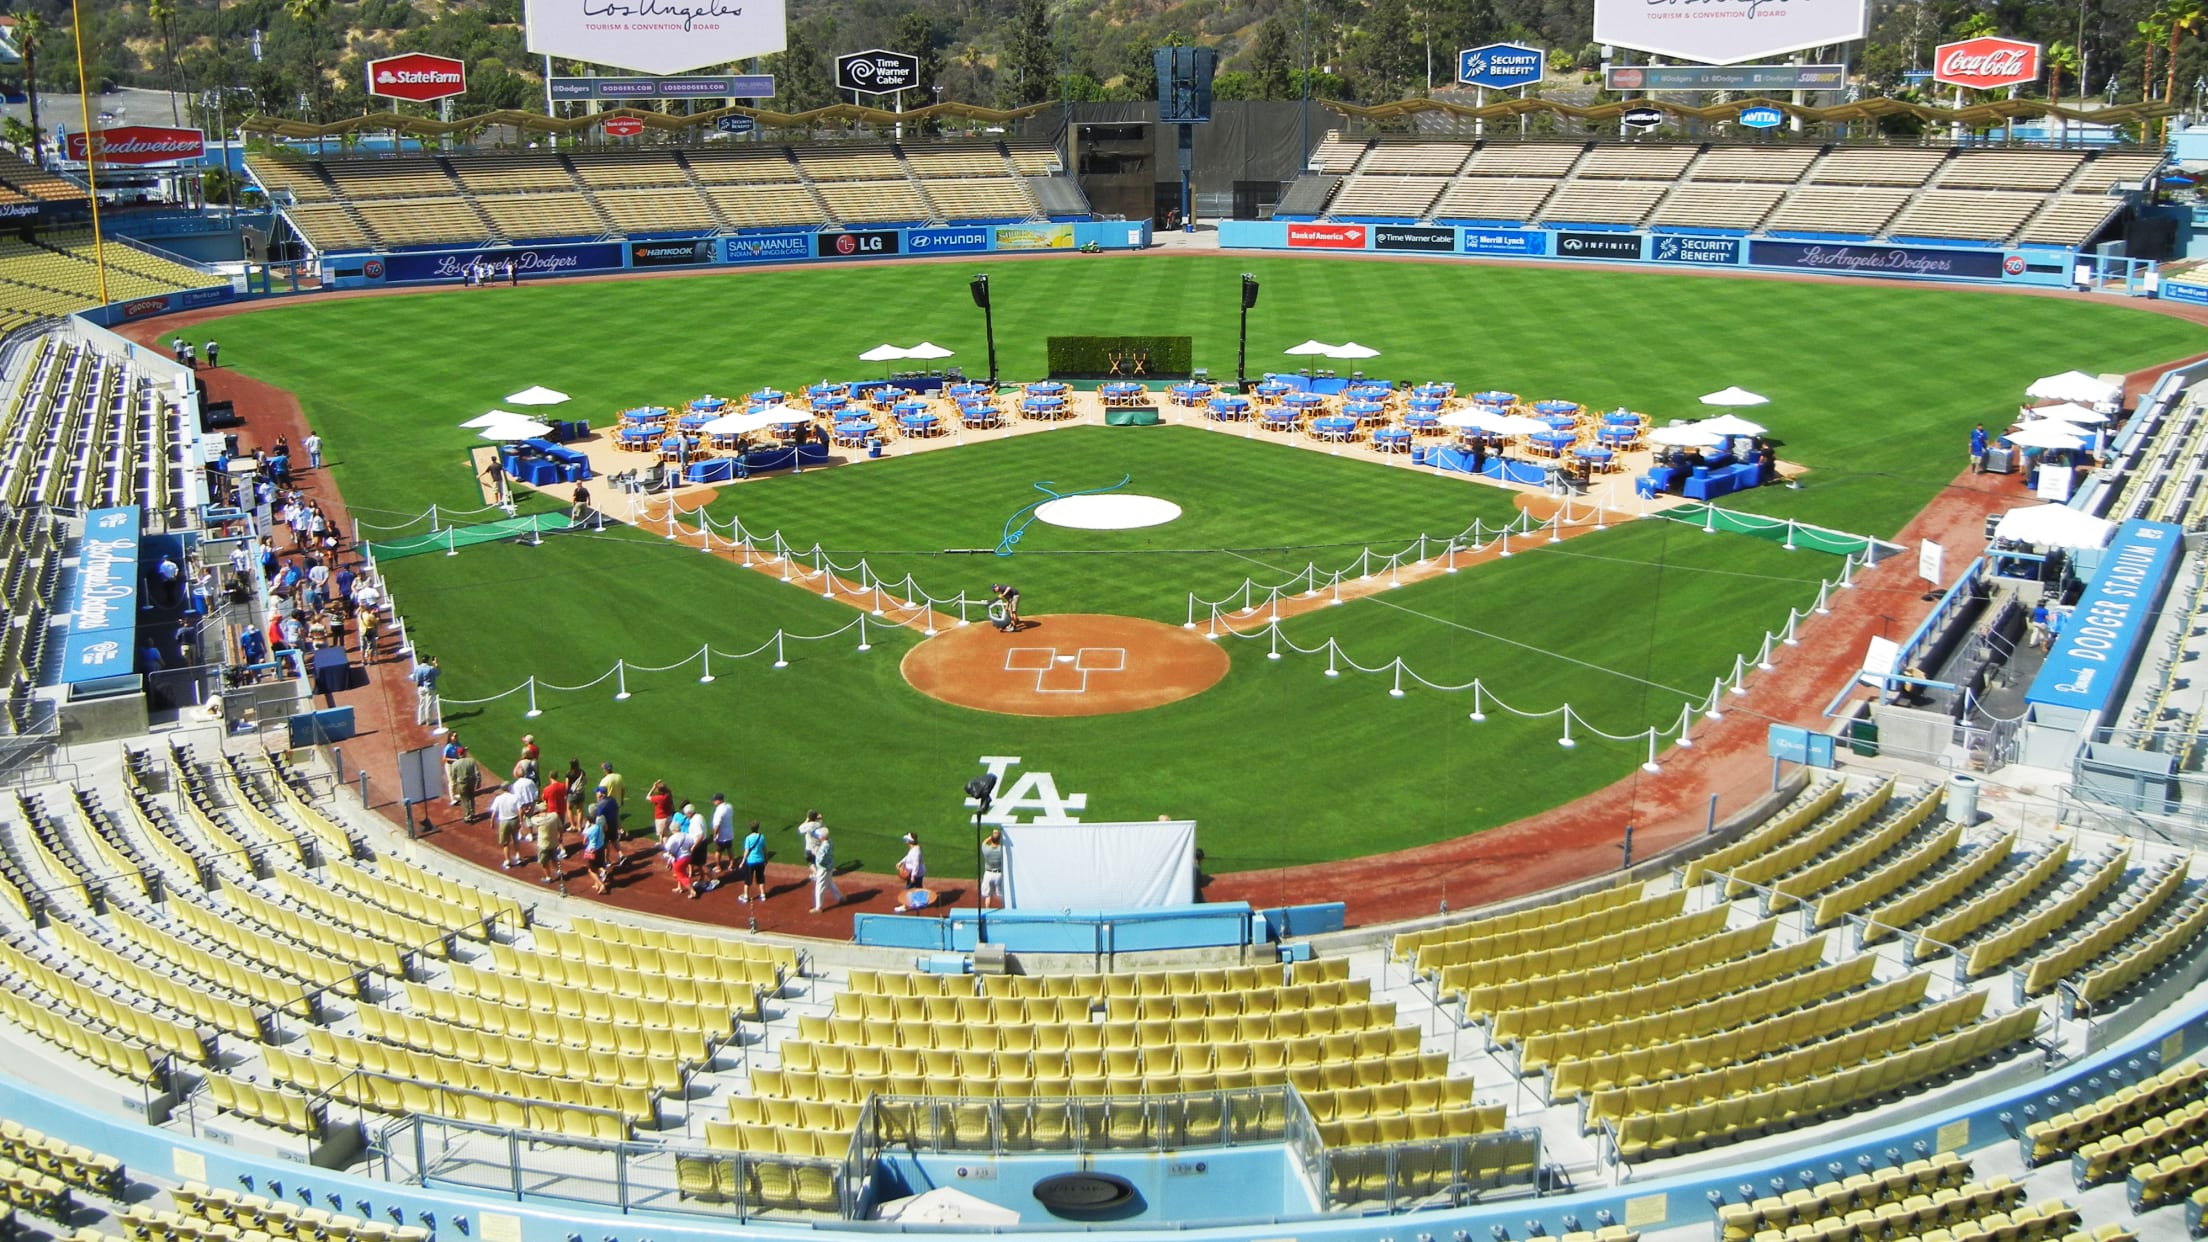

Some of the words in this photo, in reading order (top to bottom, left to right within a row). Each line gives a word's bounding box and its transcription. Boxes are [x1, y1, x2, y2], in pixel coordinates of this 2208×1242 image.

[1693, 11, 1745, 19] CONVENTION
[876, 58, 899, 67] Time
[1490, 55, 1537, 65] SECURITY
[1942, 49, 2029, 77] Coca-Cola
[876, 67, 910, 76] Warner
[876, 76, 903, 85] Cable
[552, 85, 590, 94] @Dodgers
[1743, 111, 1777, 122] AVITA
[73, 136, 200, 157] Budweiser
[860, 236, 883, 251] LG
[934, 234, 985, 245] HYUNDAI
[1386, 233, 1404, 241] Time
[1405, 234, 1429, 242] Warner
[1431, 235, 1452, 243] Cable
[1480, 235, 1503, 244] Merrill
[1504, 236, 1525, 245] Lynch
[728, 241, 752, 252] SAN
[761, 238, 807, 250] MANUEL
[1585, 241, 1635, 250] INFINITI
[1681, 239, 1734, 251] SECURITY
[434, 256, 461, 276] Los
[517, 251, 577, 272] Dodgers
[1797, 246, 1824, 265] Los
[1823, 248, 1885, 270] Angeles
[1884, 250, 1952, 275] Dodgers
[2006, 260, 2024, 271] 76
[78, 553, 134, 587] Angeles
[71, 586, 133, 629] Dodgers
[2067, 600, 2131, 661] DODGER
[2101, 544, 2158, 598] STADIUM
[964, 755, 1087, 824] LA
